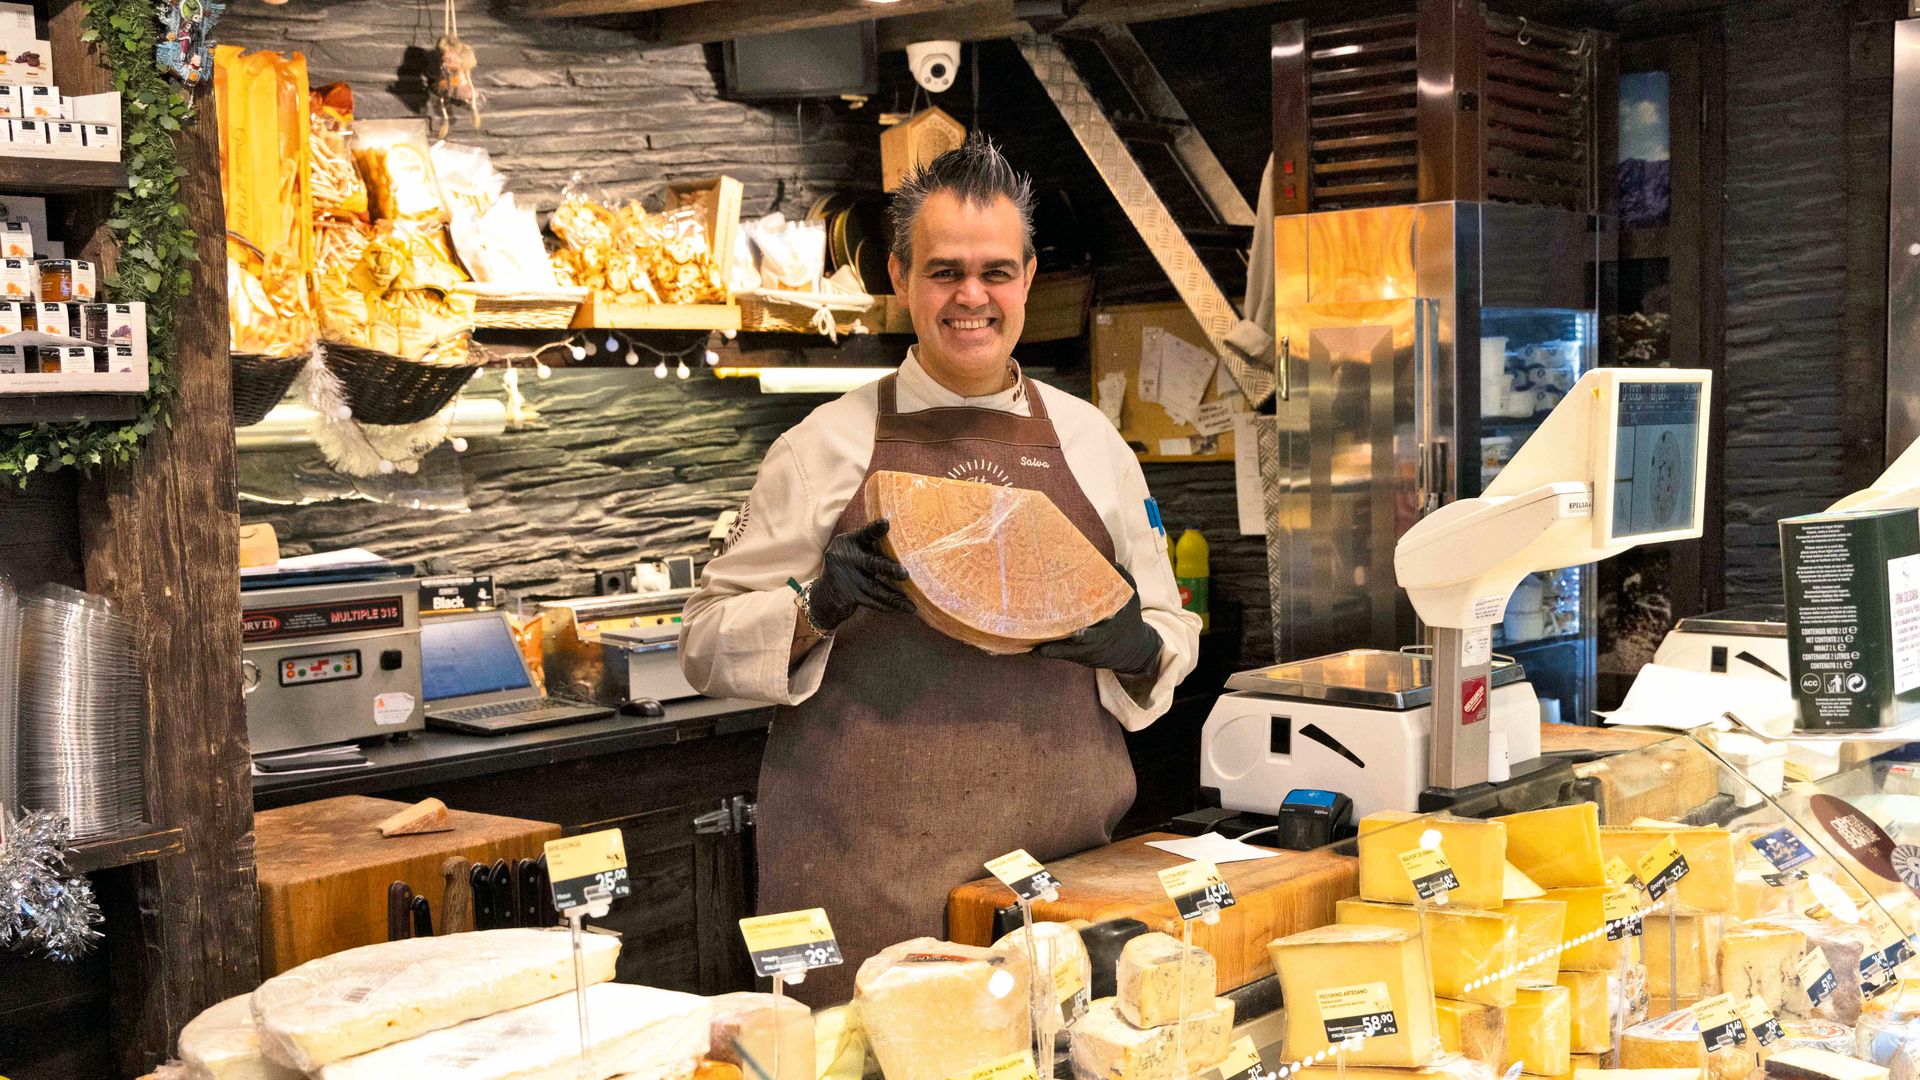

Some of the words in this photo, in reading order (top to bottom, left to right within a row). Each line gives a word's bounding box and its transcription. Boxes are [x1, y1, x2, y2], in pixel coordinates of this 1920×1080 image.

[1020, 456, 1050, 469] Salva
[433, 595, 464, 609] Black
[331, 609, 379, 623] MULTIPLE
[381, 607, 398, 618] 315
[595, 868, 627, 891] 25,00
[1343, 988, 1367, 997] ARTESANO
[1362, 1013, 1393, 1036] 58,90
